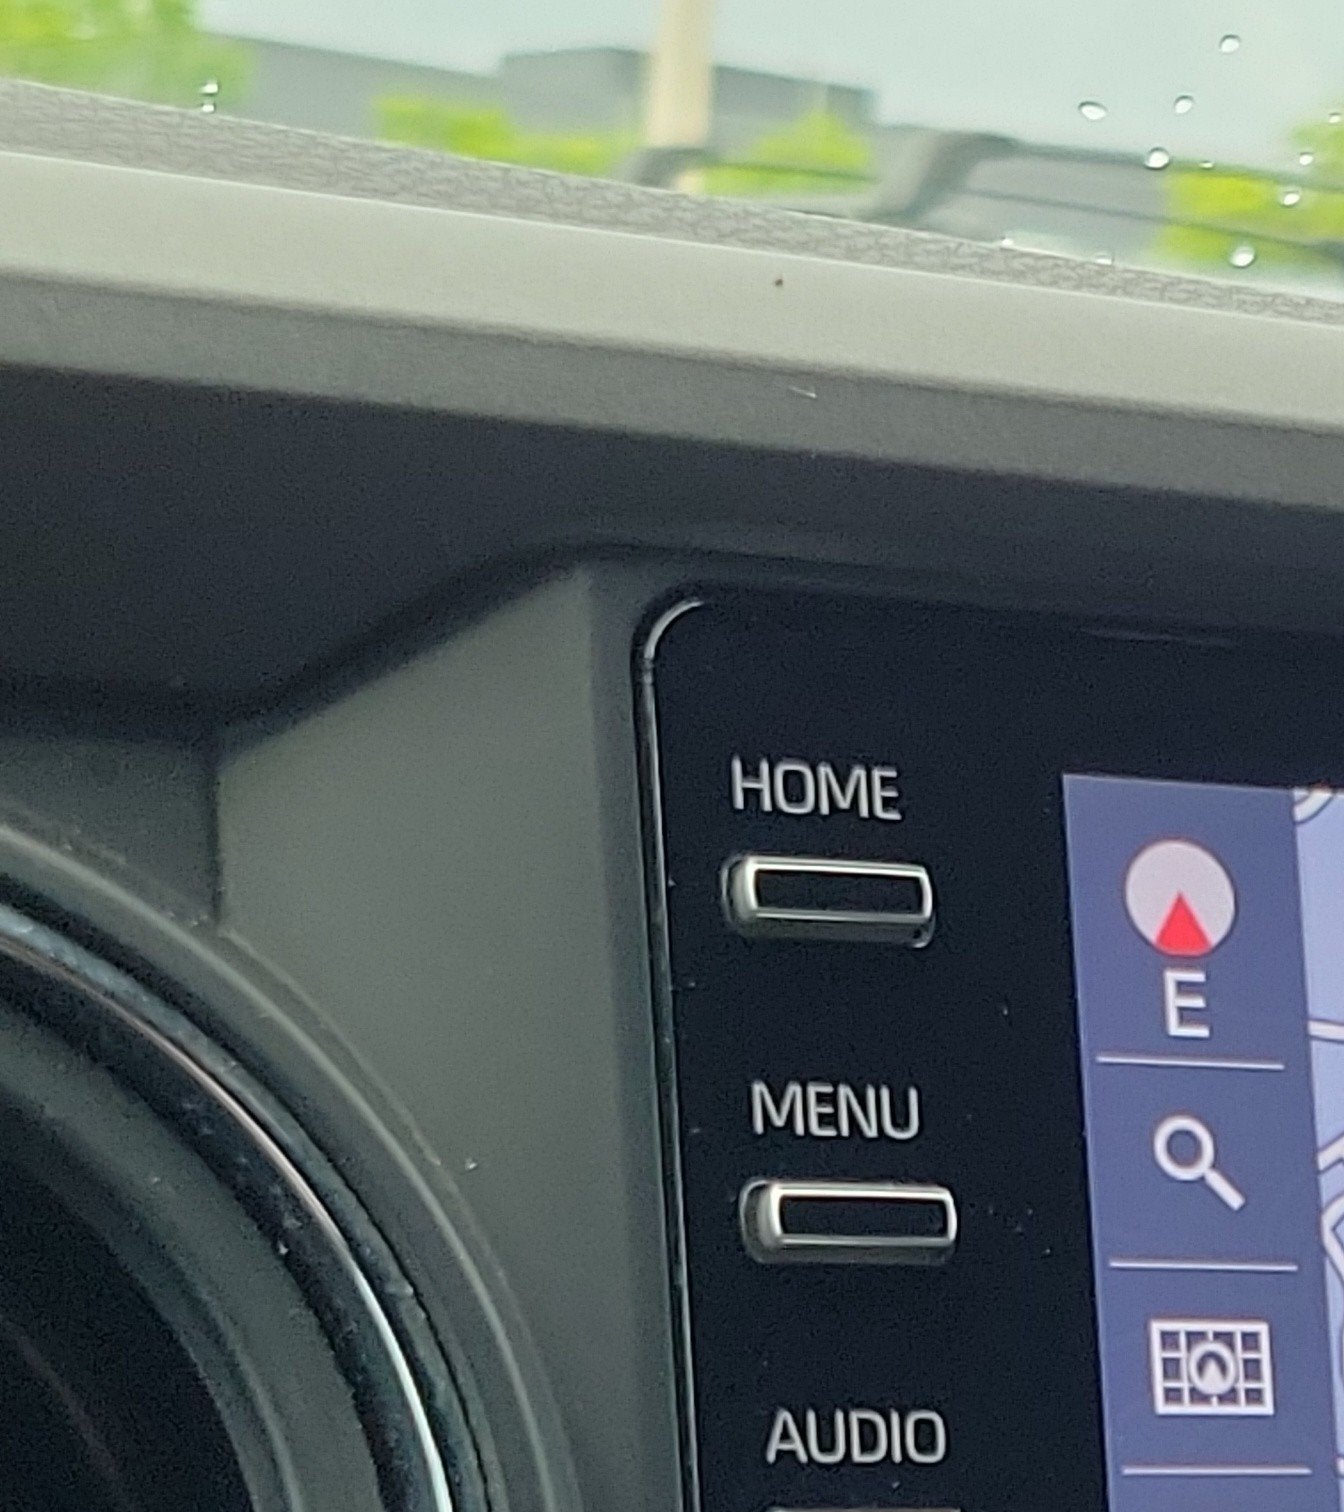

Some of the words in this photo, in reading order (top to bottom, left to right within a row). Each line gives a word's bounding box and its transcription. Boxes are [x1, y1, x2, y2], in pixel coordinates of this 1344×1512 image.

[730, 757, 902, 820] HOME
[1163, 969, 1209, 1038] E
[751, 1080, 921, 1140] MENU
[766, 1407, 948, 1465] AUDIO
